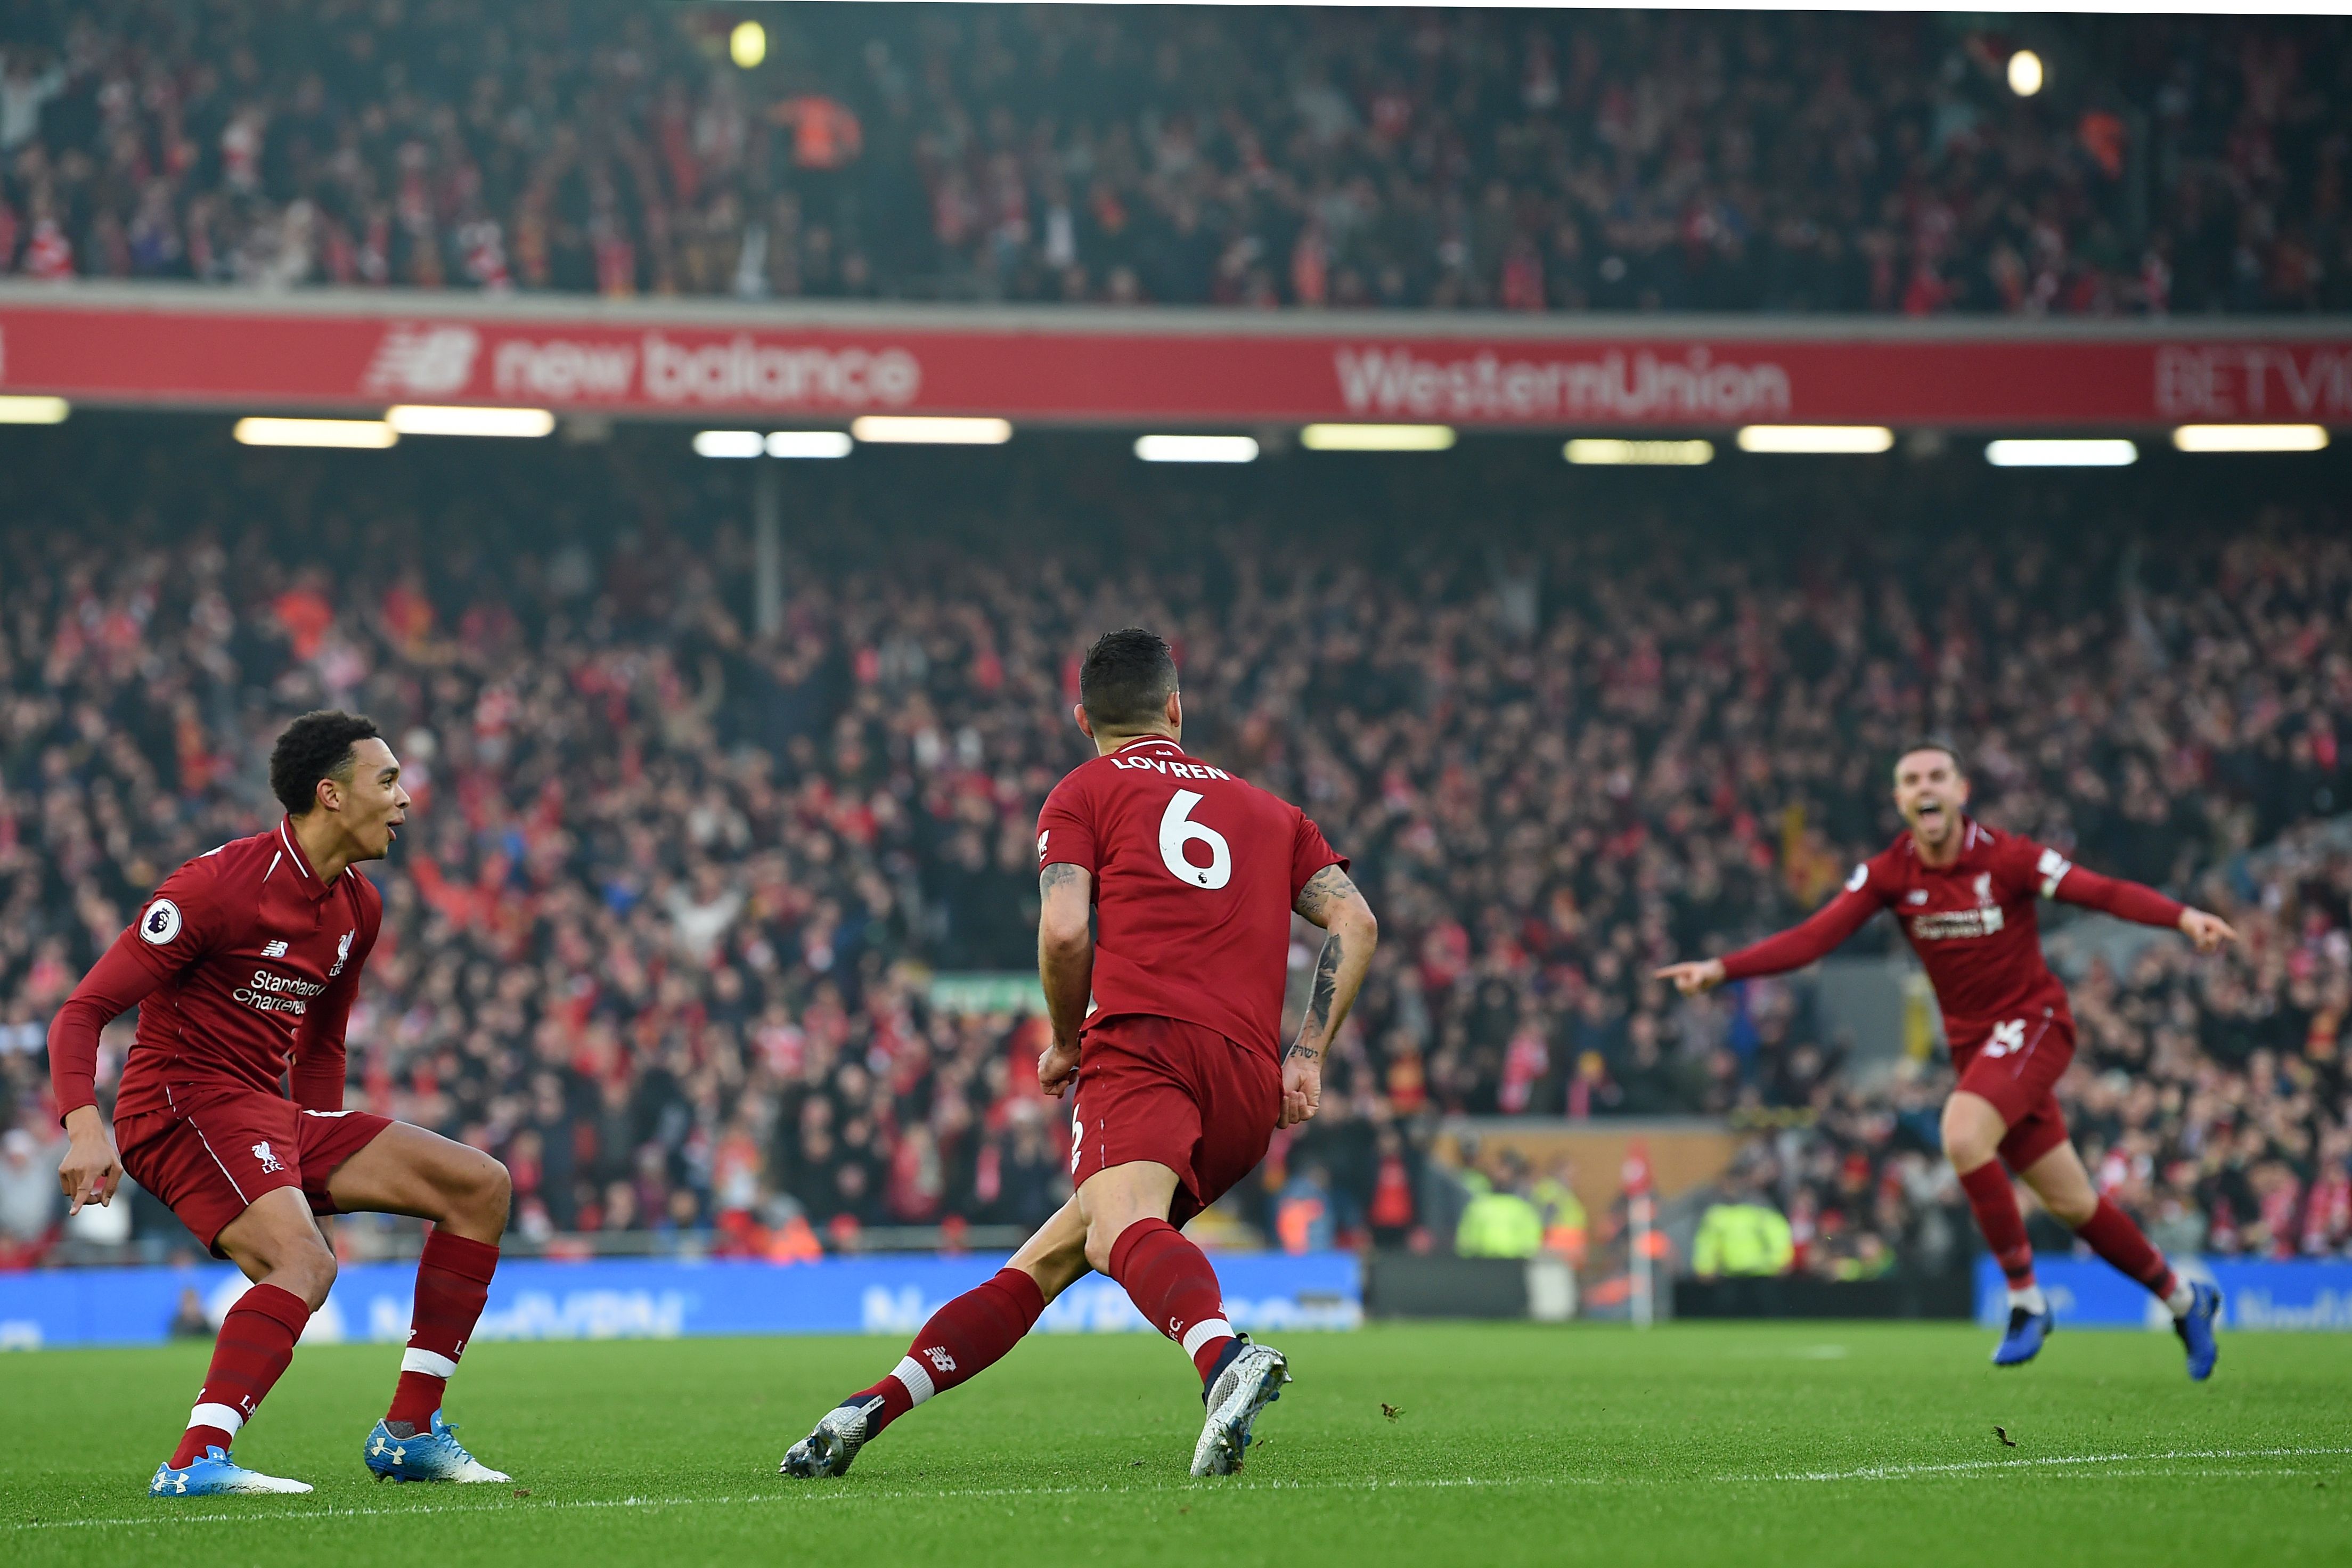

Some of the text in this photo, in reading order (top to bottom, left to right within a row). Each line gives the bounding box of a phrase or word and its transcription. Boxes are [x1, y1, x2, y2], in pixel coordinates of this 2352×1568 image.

[492, 338, 636, 396] new
[642, 328, 920, 407] balance
[2153, 345, 2352, 419] BETVI
[1110, 756, 1230, 781] LOVREN
[1159, 788, 1231, 889] 6
[250, 970, 327, 997] Standard
[329, 965, 344, 976] LFC
[262, 1163, 284, 1174] LFC
